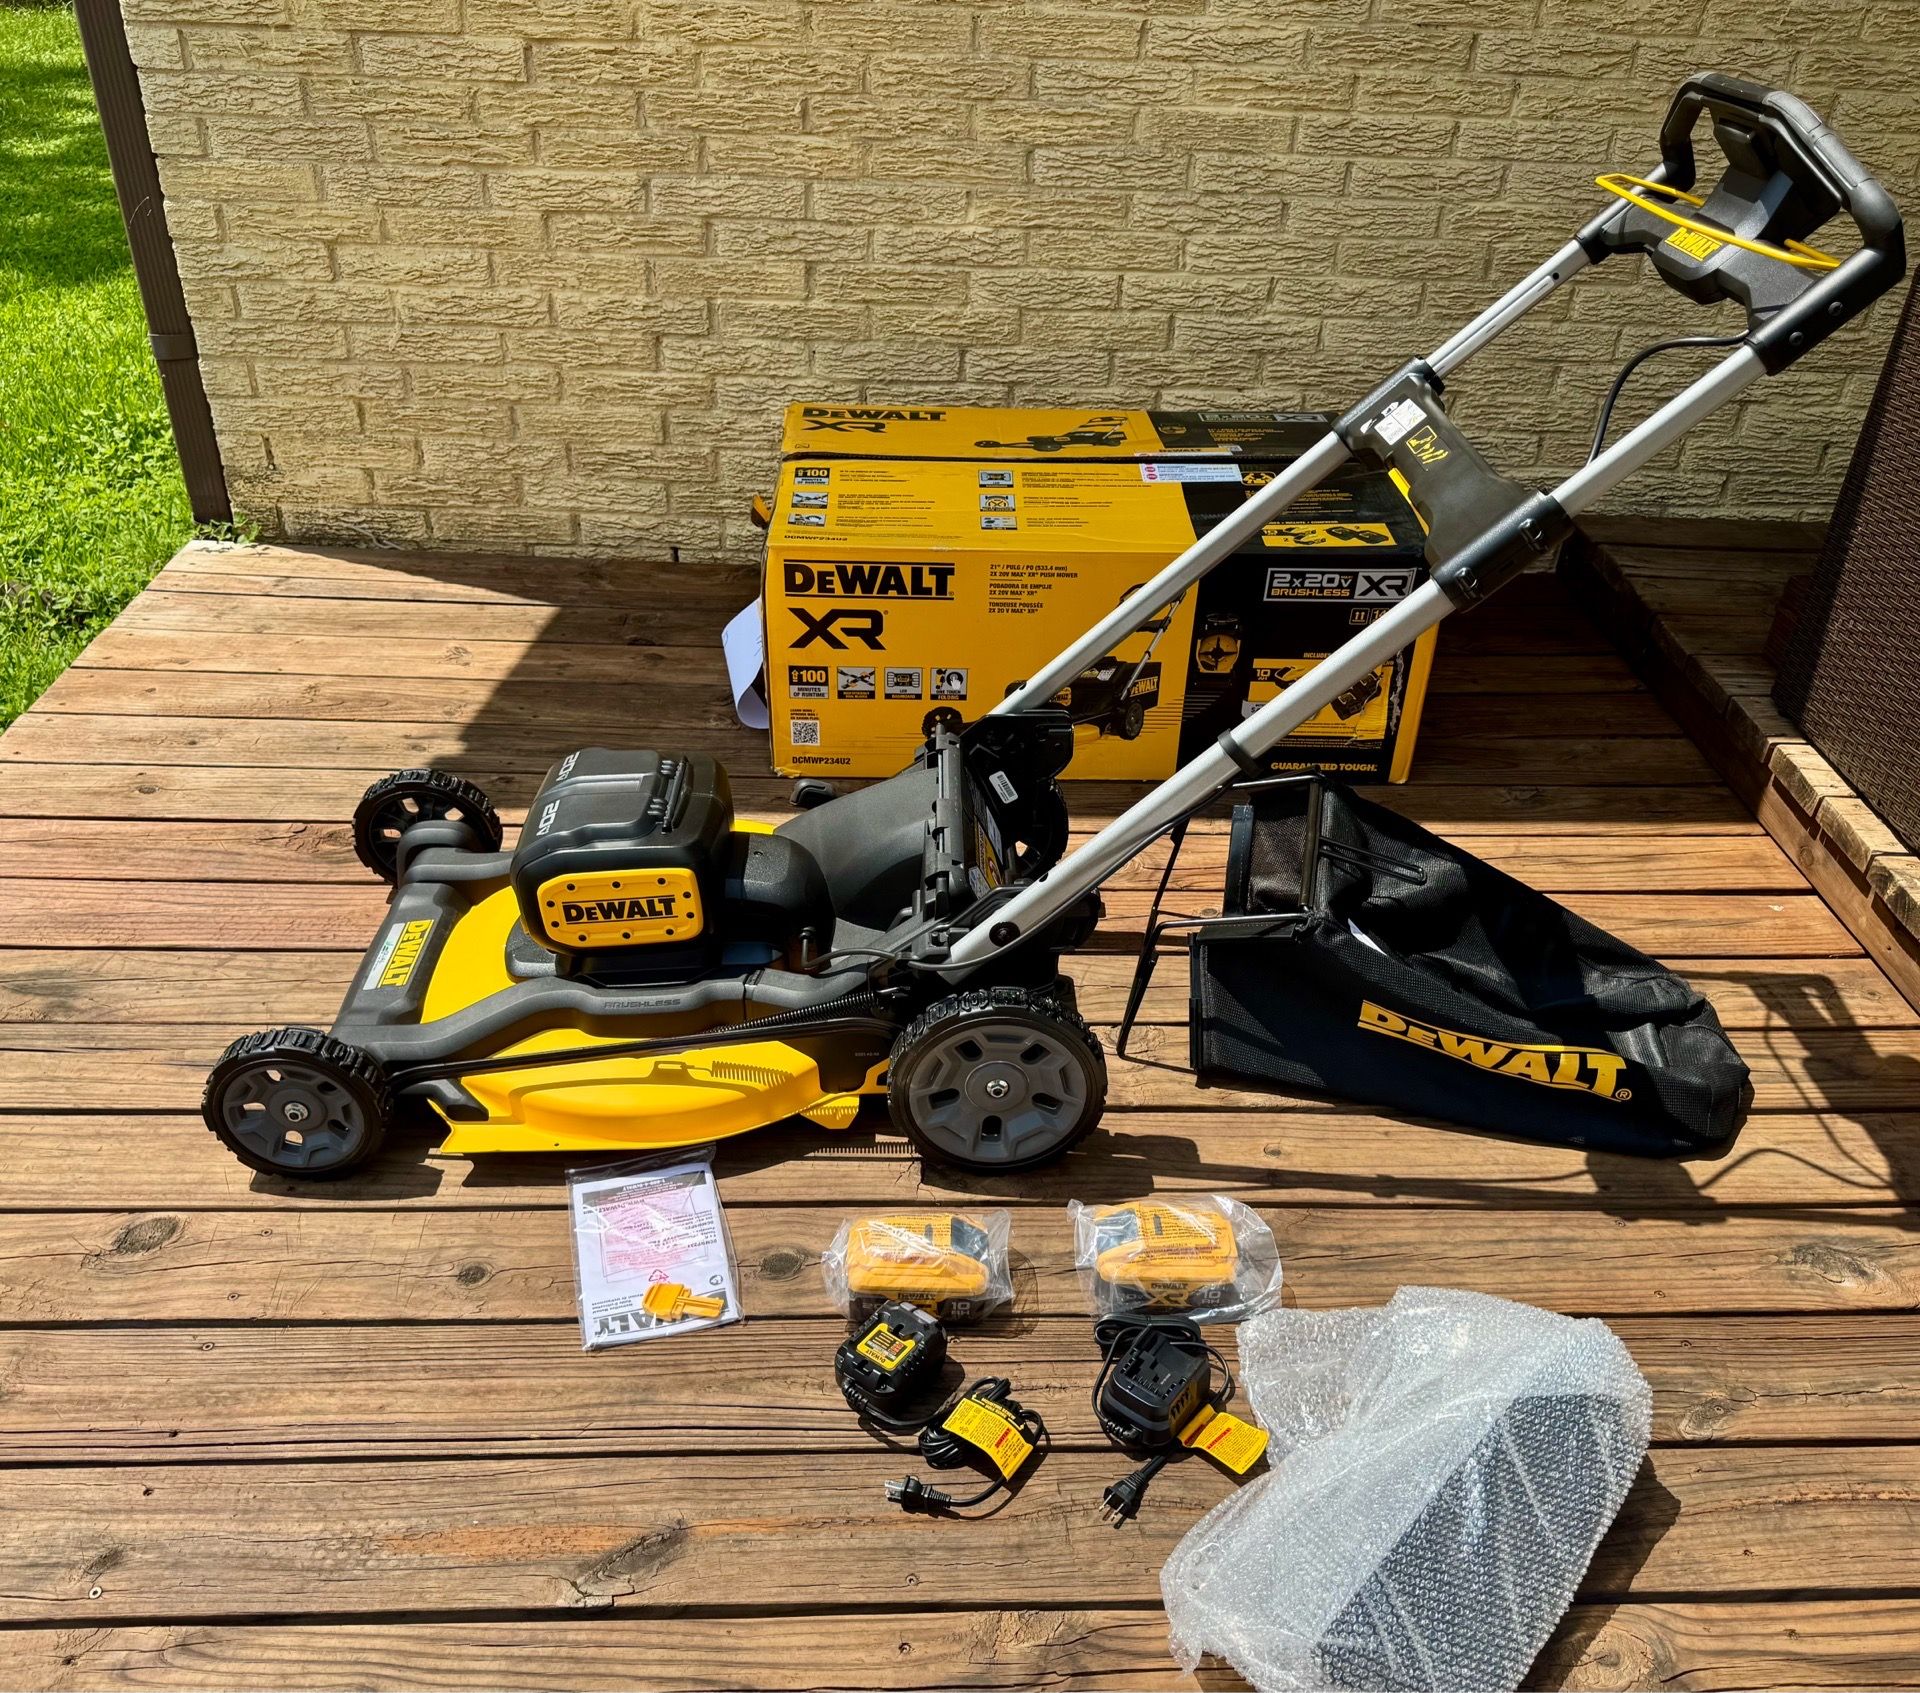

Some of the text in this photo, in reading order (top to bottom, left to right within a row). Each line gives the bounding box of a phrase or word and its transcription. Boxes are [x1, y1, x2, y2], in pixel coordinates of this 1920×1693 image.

[1664, 227, 1722, 261] DEWALT
[802, 408, 946, 421] DEWALT
[801, 419, 887, 433] XR
[806, 469, 828, 477] 100
[783, 562, 954, 597] DEWALT
[1271, 588, 1350, 597] BRUSHLESS
[800, 669, 826, 683] 100
[1256, 669, 1270, 677] 10
[556, 751, 580, 782] 20V
[792, 756, 851, 765] DCMWP234U2
[1270, 762, 1338, 771] GUARAEED
[536, 800, 560, 836] 20V
[562, 897, 676, 922] DEWALT
[382, 919, 432, 986] DEWALT
[1204, 1291, 1221, 1299] 10
